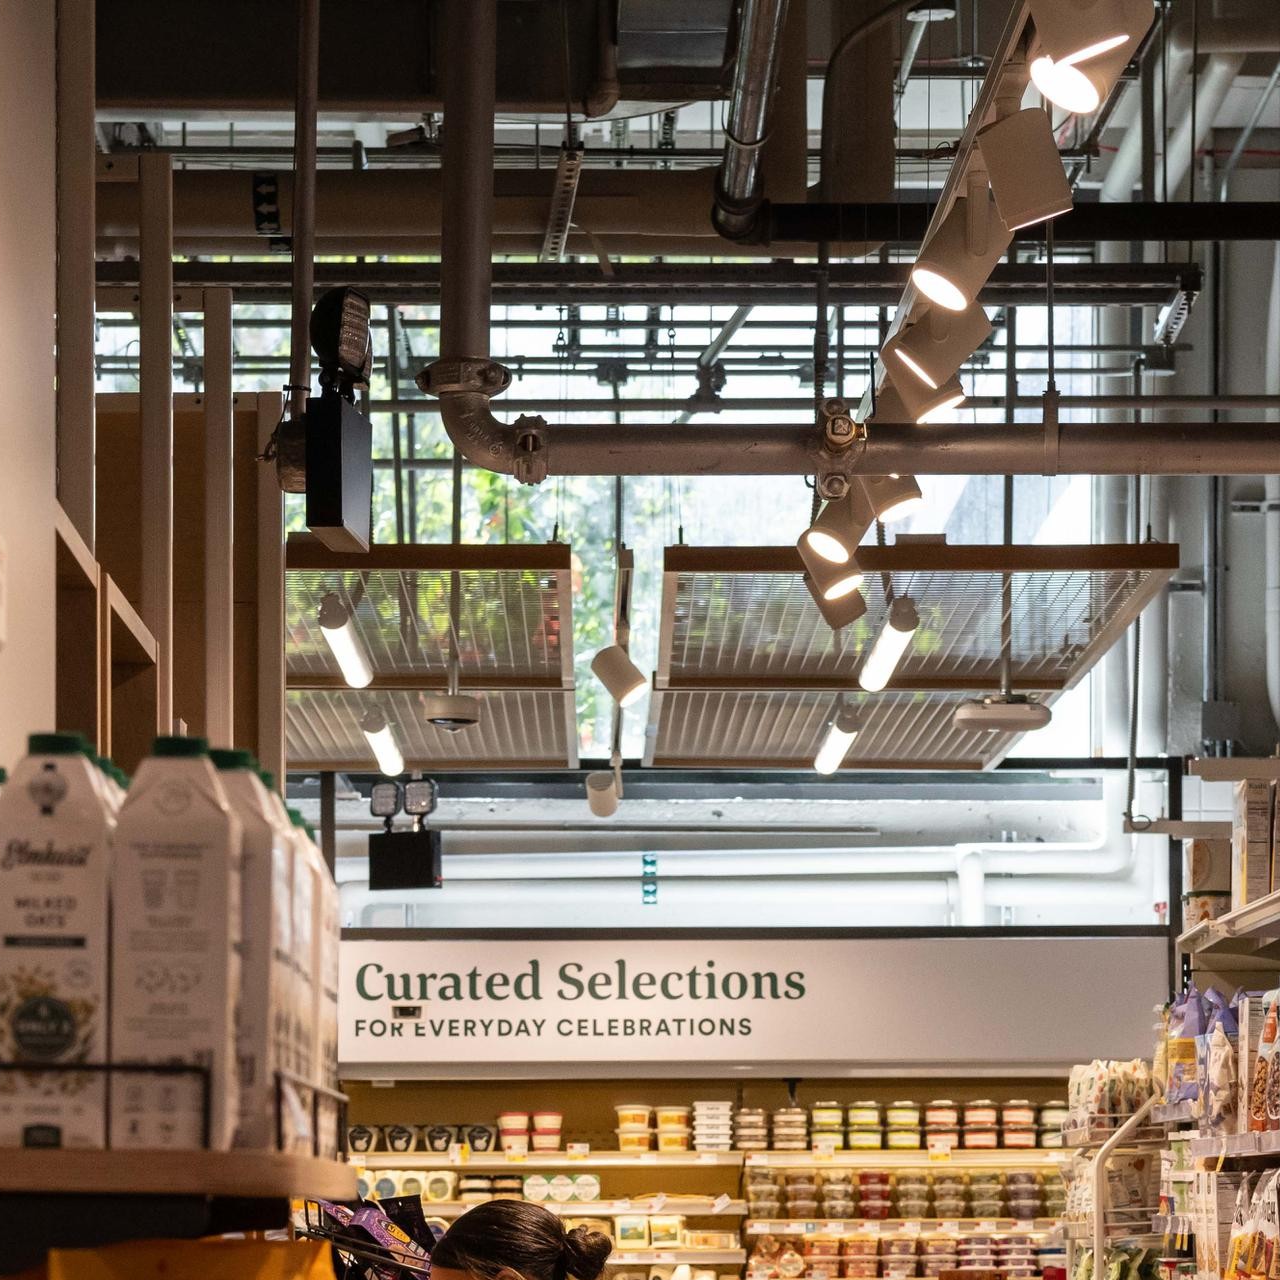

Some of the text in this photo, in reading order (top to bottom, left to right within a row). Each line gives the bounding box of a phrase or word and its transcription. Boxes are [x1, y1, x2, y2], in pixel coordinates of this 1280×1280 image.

[356, 959, 806, 1001] Curated Selections
[355, 1018, 752, 1038] FOR EVERYDAY CELEBRATIONS
